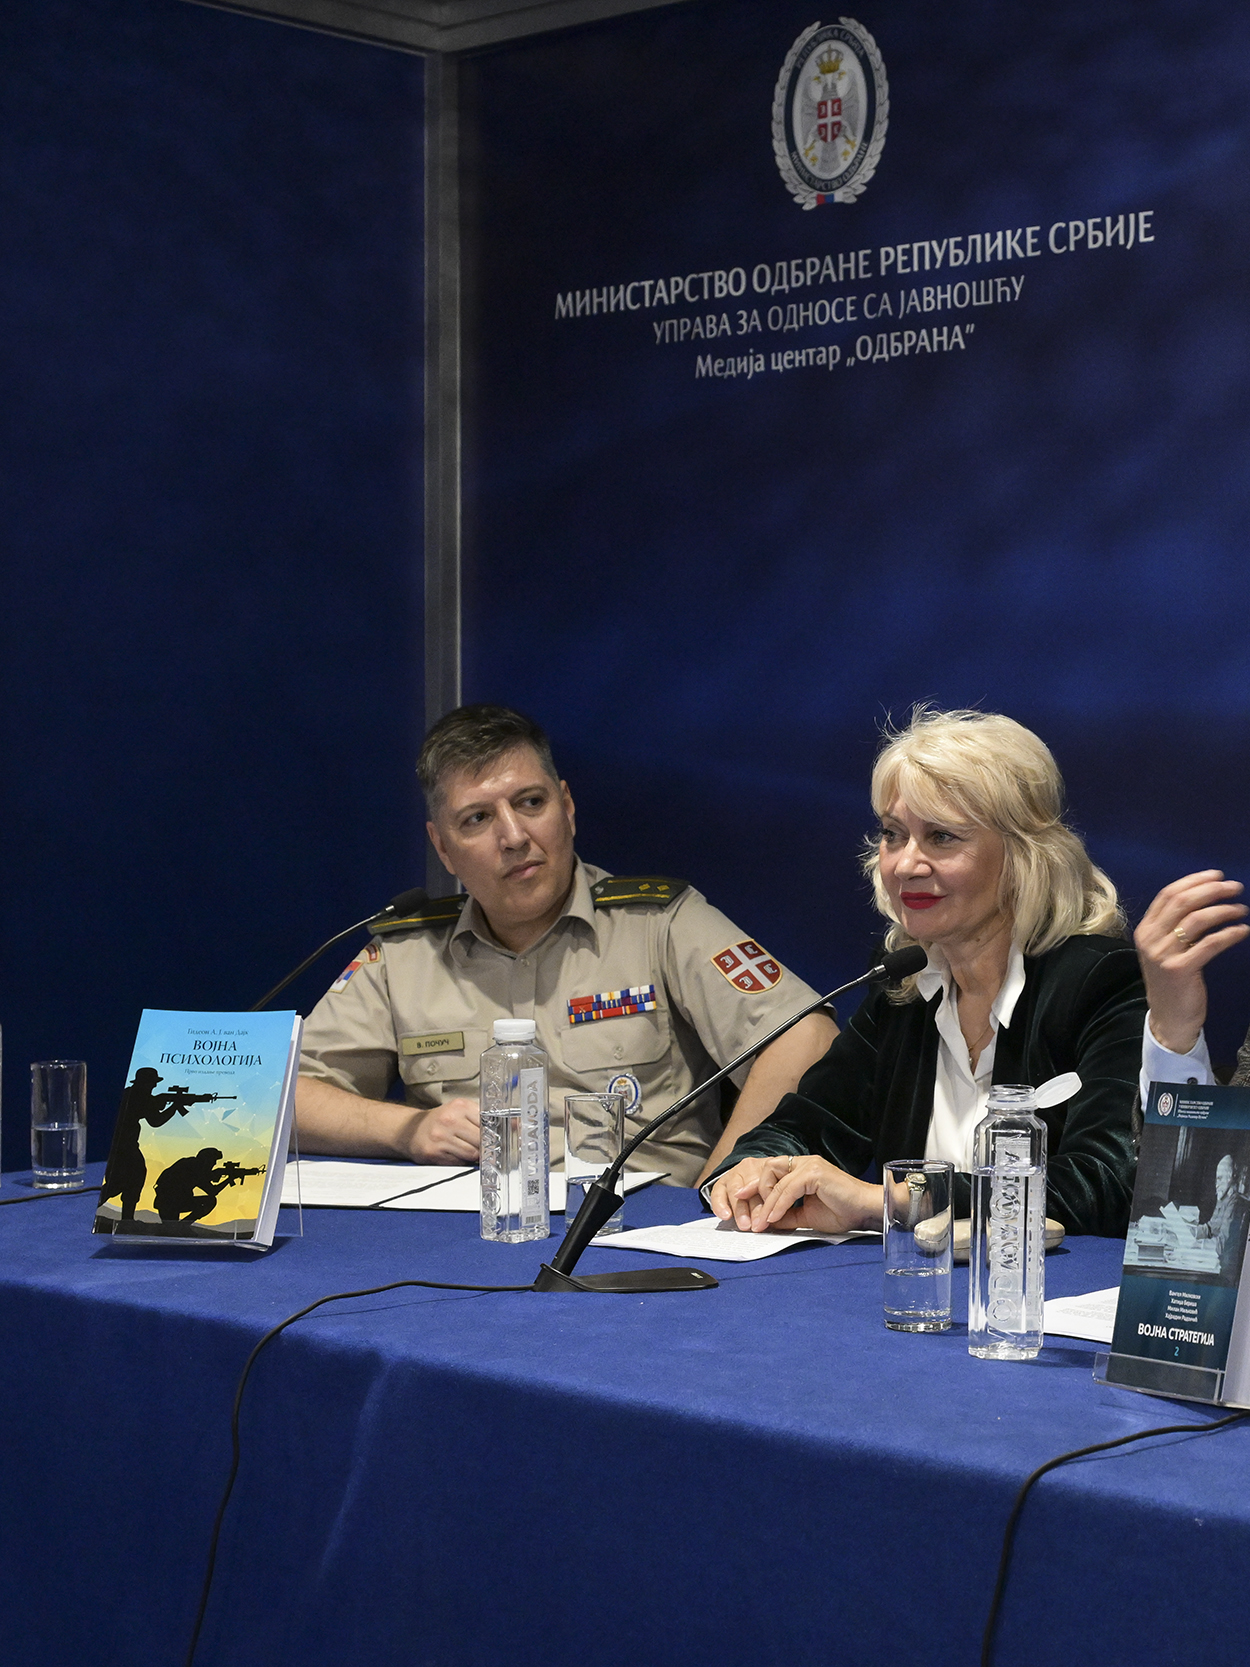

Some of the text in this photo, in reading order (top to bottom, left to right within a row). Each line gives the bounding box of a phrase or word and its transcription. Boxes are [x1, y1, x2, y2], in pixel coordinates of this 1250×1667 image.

[556, 211, 1154, 318] МИНИСТАРСТВО ОДБРАНЕ РЕПУБЛИКЕ СРБИЈЕ
[654, 275, 1024, 342] УПРАВА ЗА ОДНОСЕ СА ЈАВНОШЋУ
[696, 349, 765, 379] Медија
[772, 345, 840, 372] центар
[160, 1052, 262, 1067] ПСИХОЛОГИЈА
[193, 1040, 237, 1052] ВОЈНА
[527, 1080, 539, 1177] VODAVODA
[1138, 1323, 1214, 1346] ВОЈНА СТРАТЕГИЈА
[1174, 1346, 1180, 1357] 2
